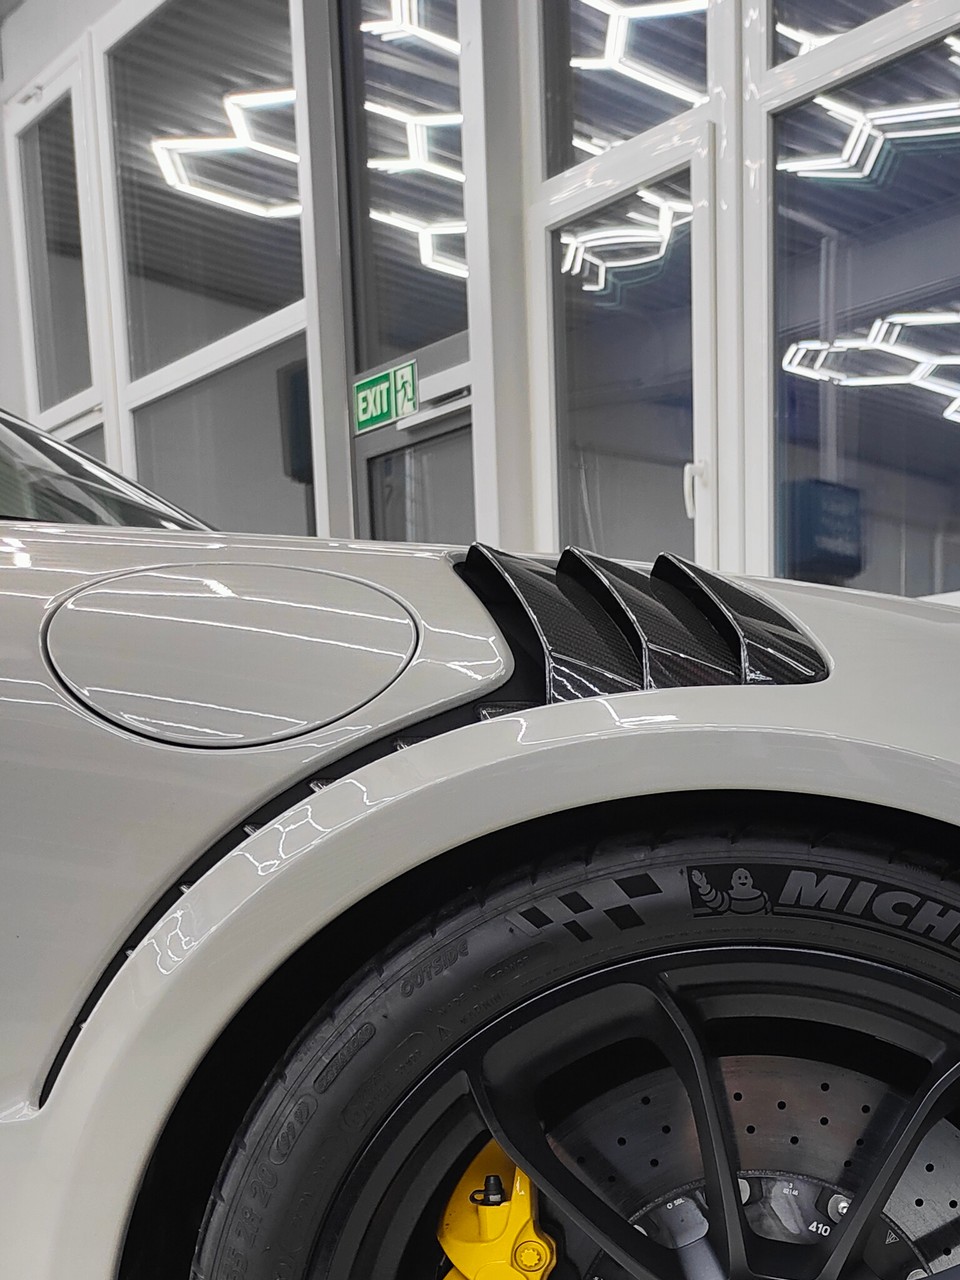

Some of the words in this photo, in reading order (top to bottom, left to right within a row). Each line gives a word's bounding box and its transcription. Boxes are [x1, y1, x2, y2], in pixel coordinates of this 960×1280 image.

[358, 381, 389, 423] EXIT
[400, 938, 470, 998] OUTSIDE
[808, 1221, 831, 1237] 410
